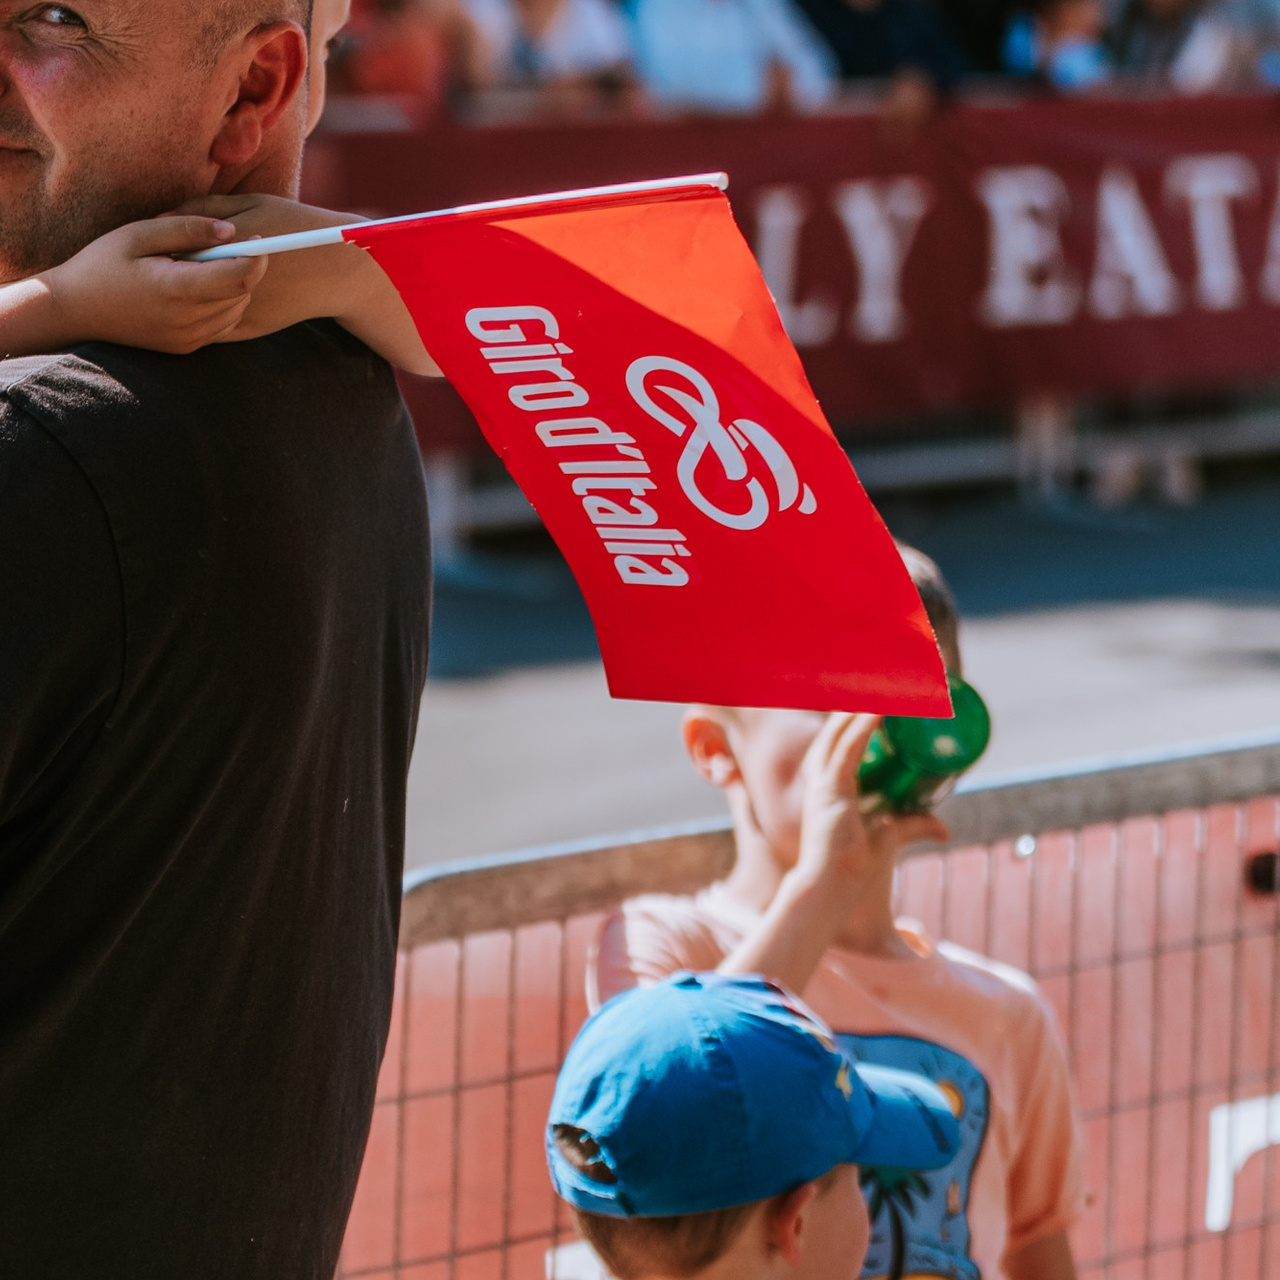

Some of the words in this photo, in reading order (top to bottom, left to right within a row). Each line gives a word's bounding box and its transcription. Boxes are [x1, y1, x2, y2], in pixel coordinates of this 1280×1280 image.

[976, 152, 1280, 327] EAT
[464, 305, 590, 412] Giro
[534, 417, 692, 587] d'Italia
